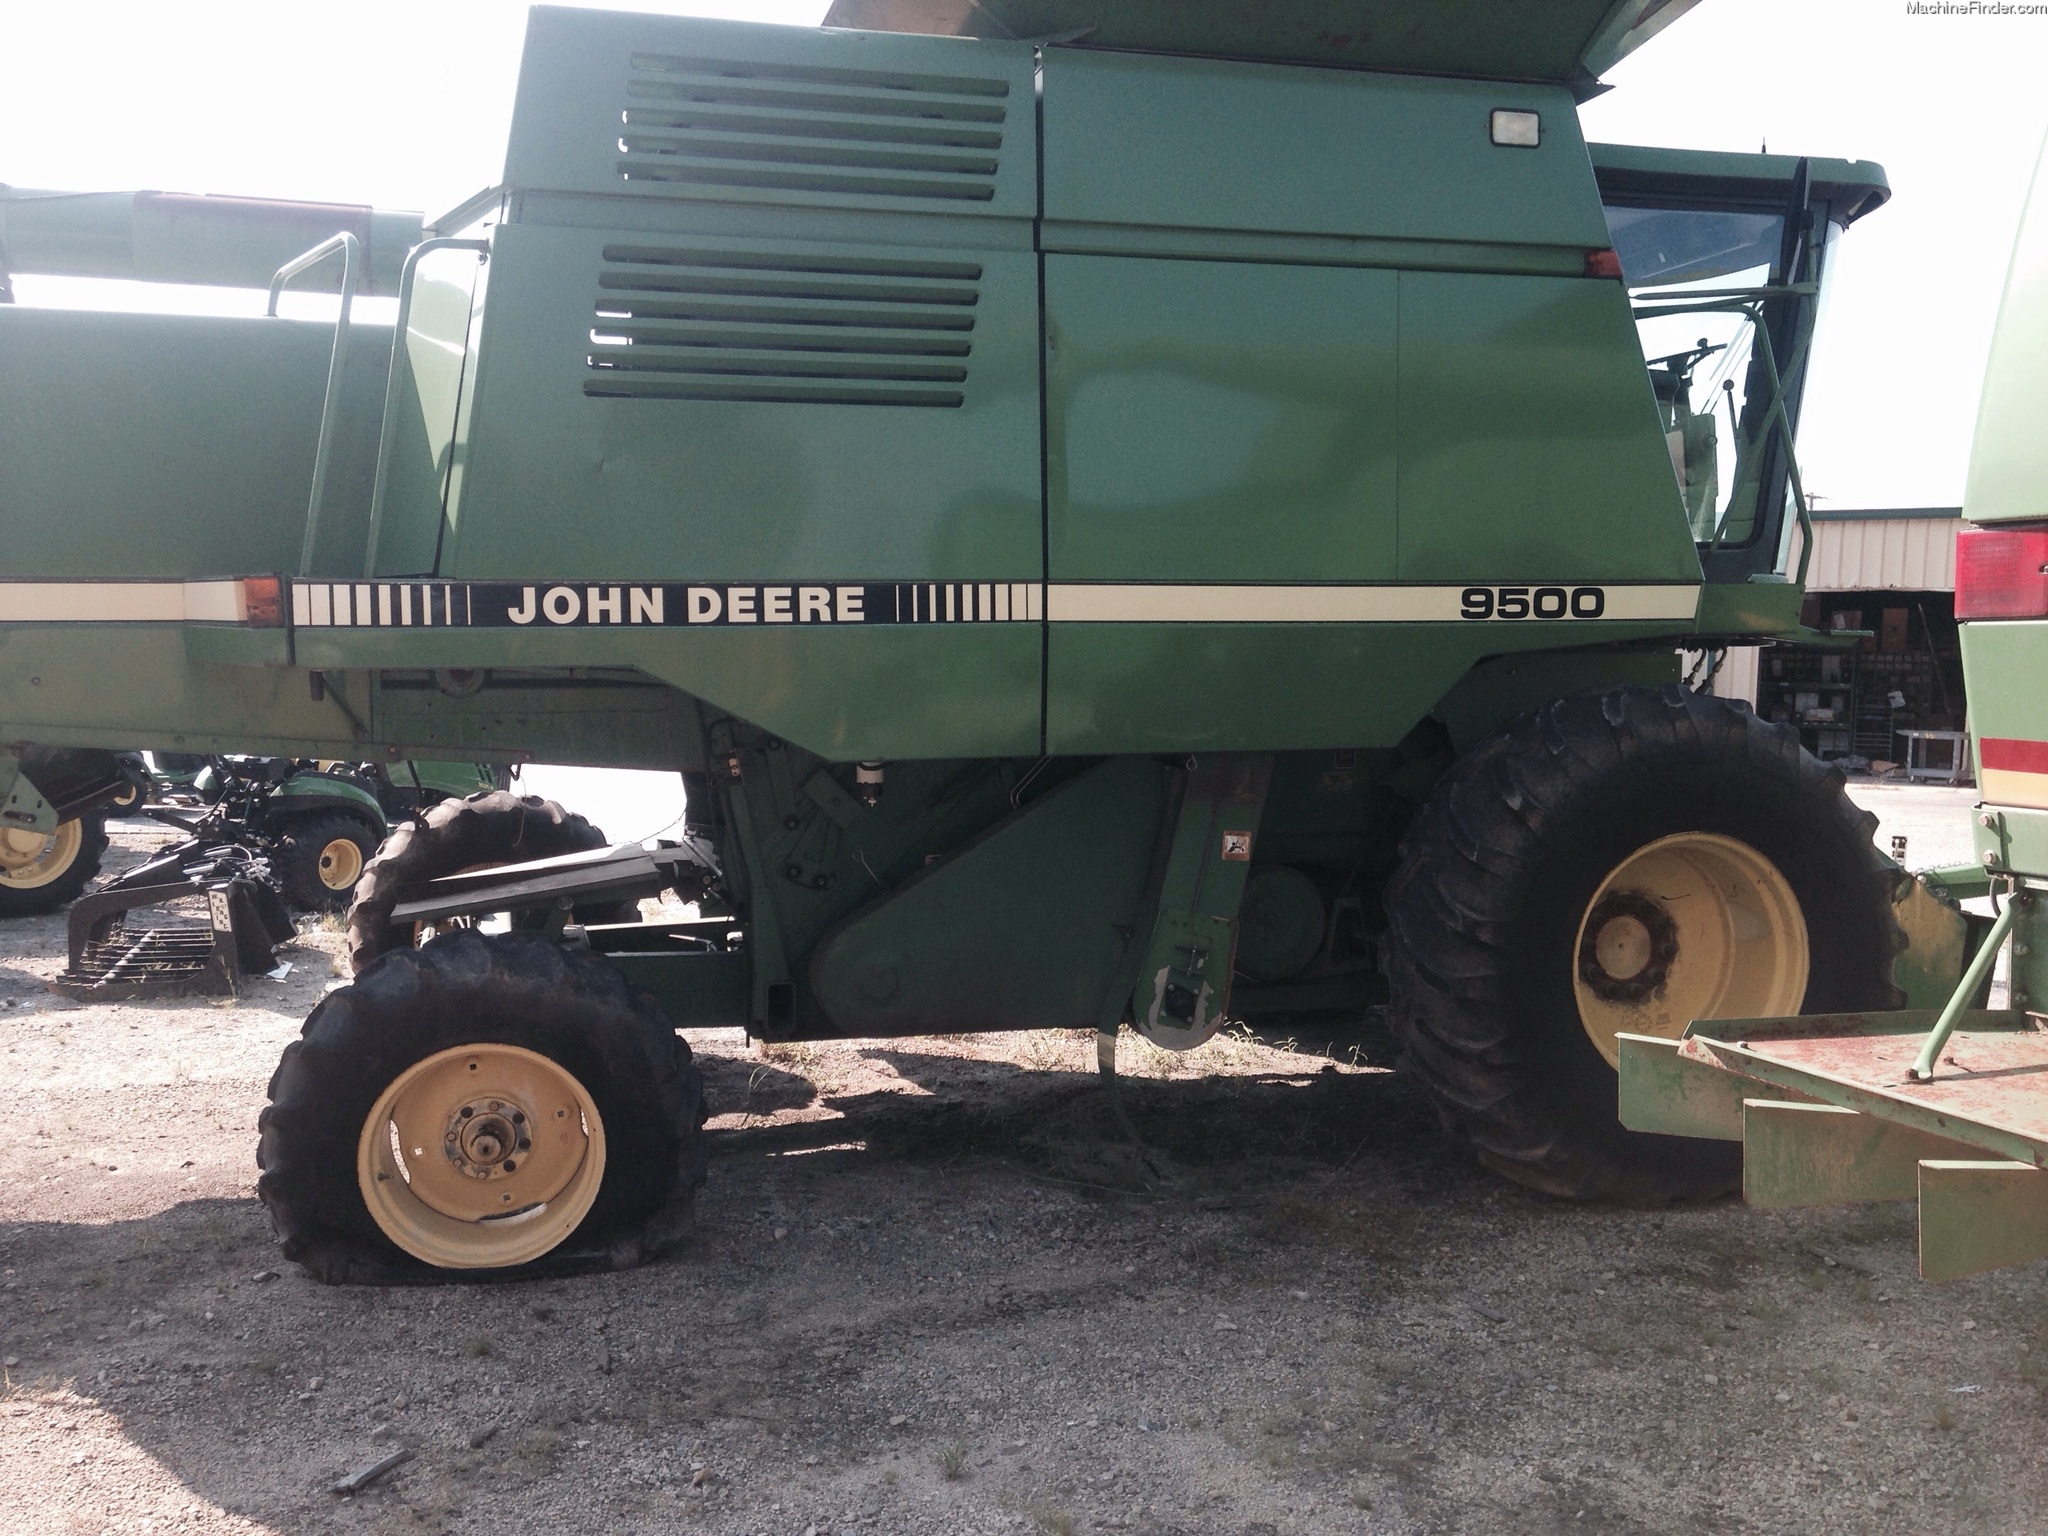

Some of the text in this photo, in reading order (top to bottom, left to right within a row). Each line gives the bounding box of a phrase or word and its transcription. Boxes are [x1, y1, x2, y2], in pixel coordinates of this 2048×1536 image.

[507, 586, 865, 624] JOHN DEERE
[1460, 587, 1605, 620] 9500
